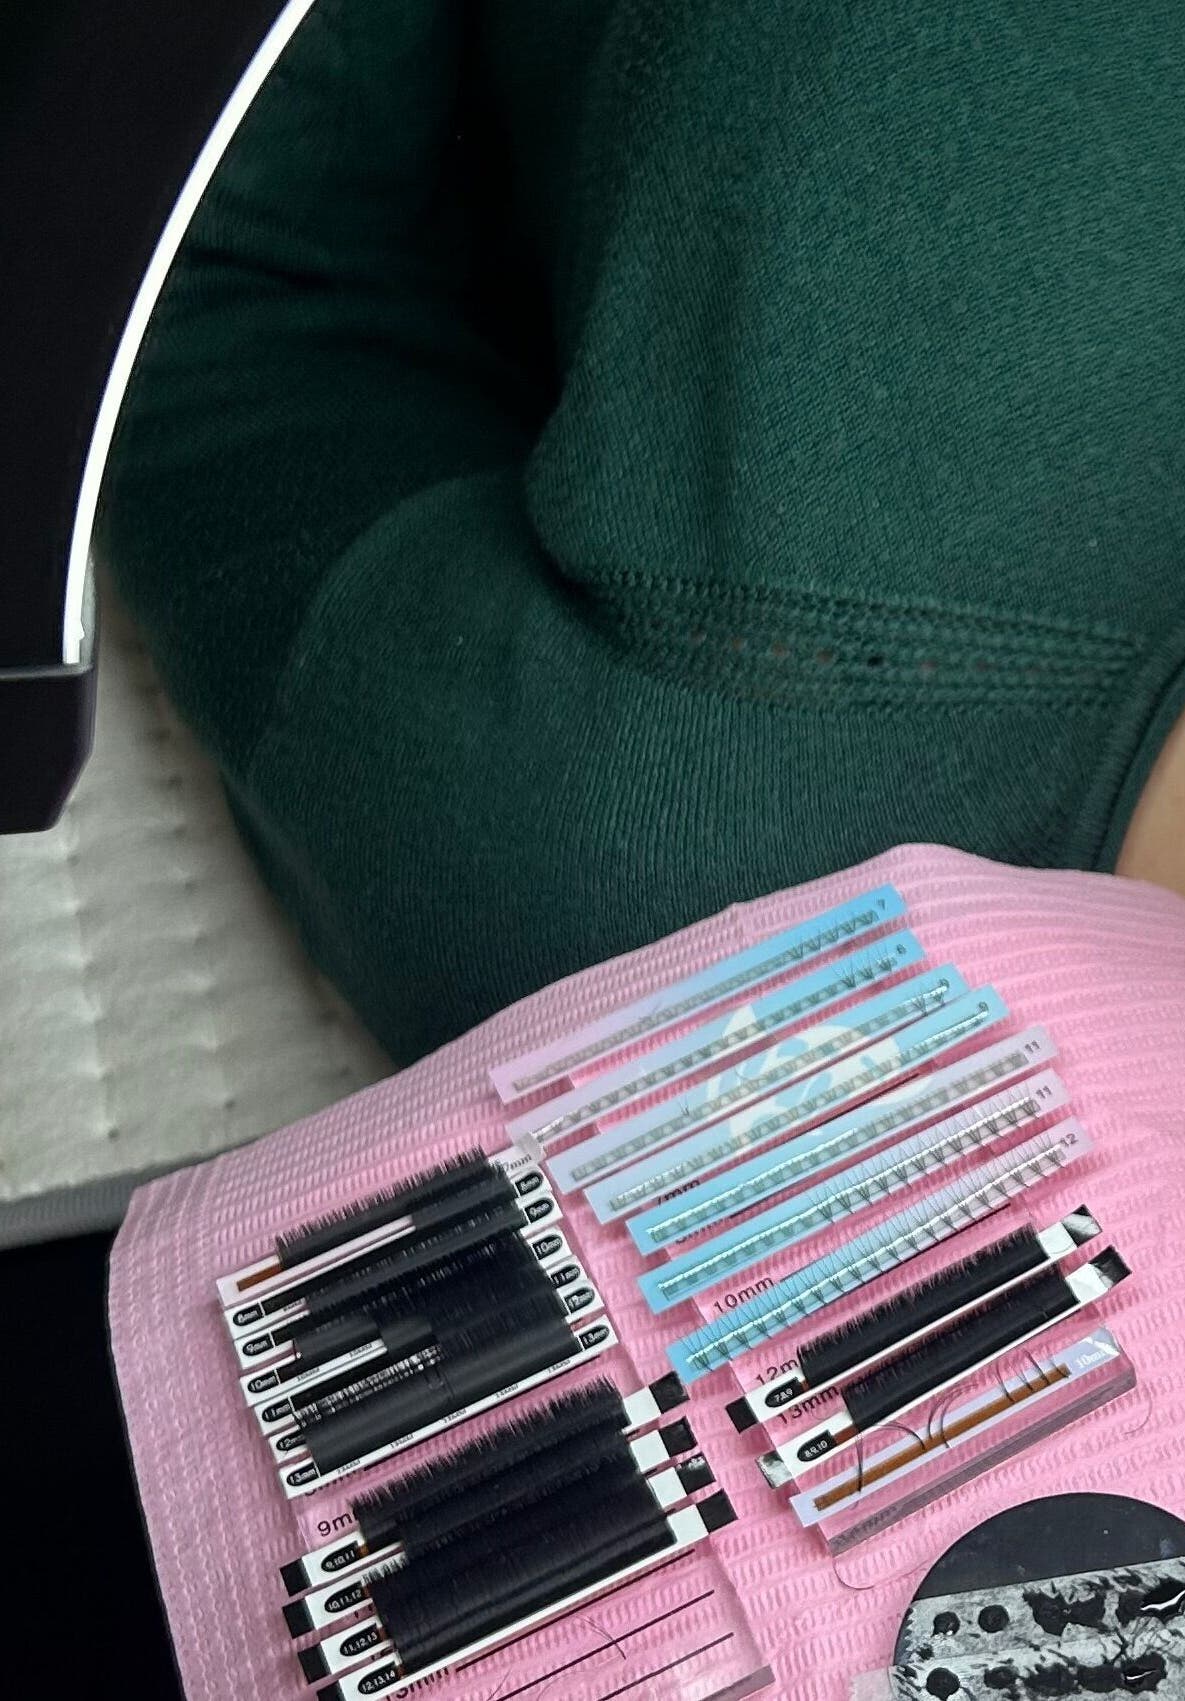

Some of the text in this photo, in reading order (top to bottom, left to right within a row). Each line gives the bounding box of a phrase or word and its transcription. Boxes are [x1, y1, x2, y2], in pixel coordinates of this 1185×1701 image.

[713, 1277, 774, 1313] 10mm
[777, 1385, 839, 1425] 13mm
[317, 1509, 358, 1537] 9m
